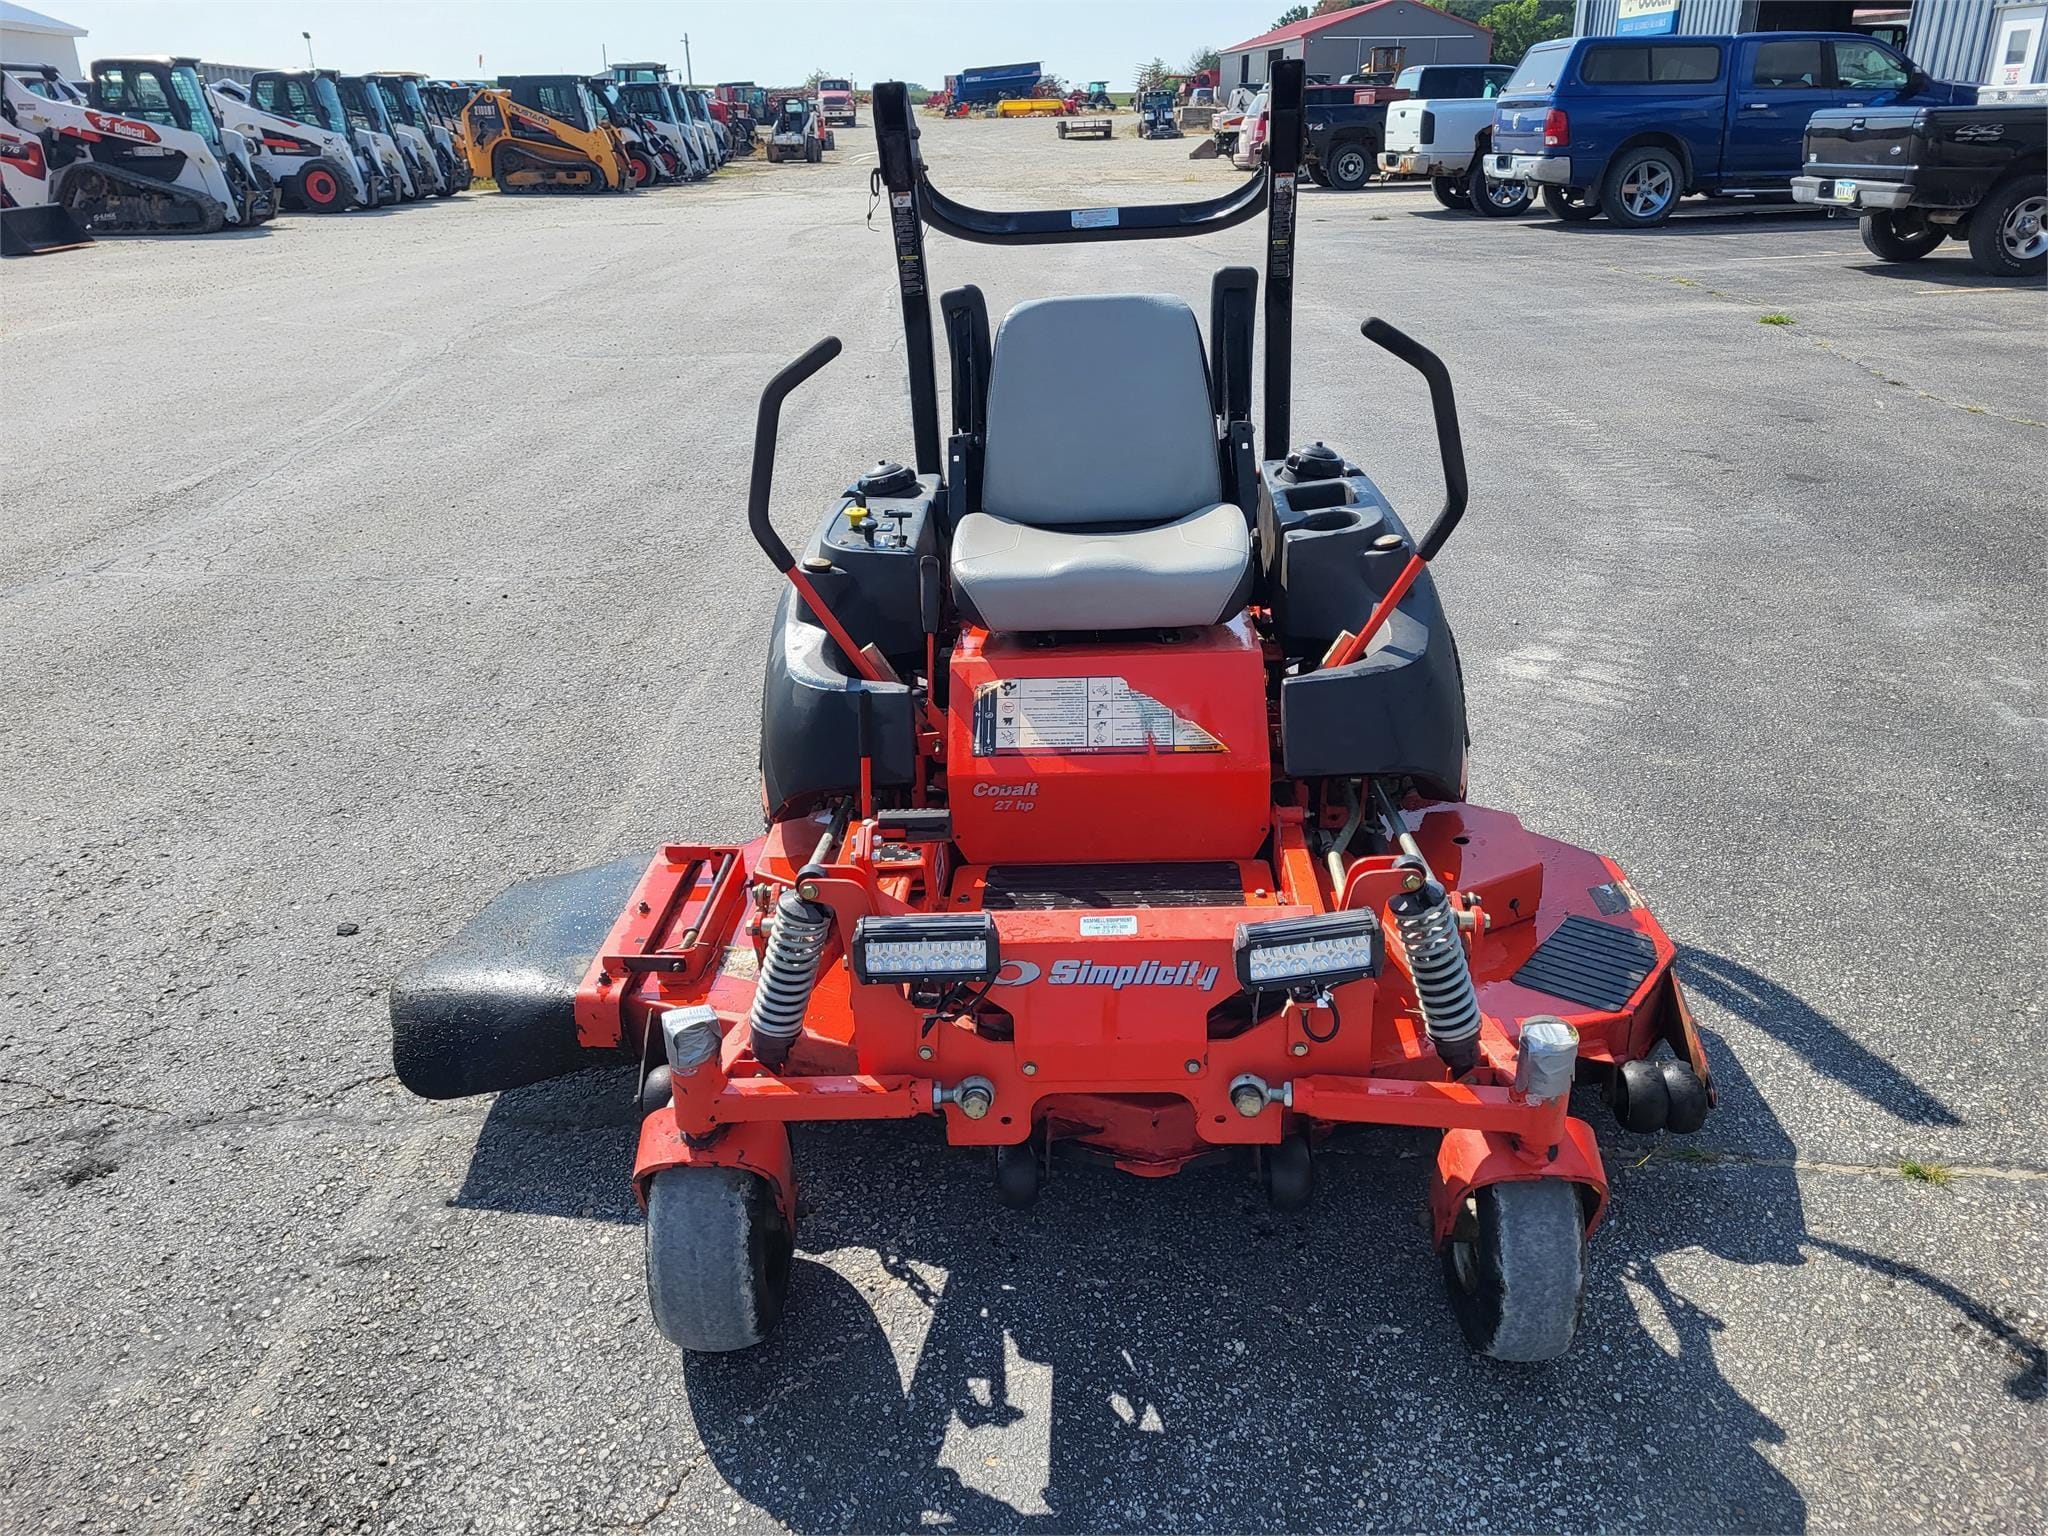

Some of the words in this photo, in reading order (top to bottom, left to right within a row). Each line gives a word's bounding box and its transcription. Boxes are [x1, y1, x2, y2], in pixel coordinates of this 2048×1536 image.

[114, 122, 146, 138] Bobcat
[973, 782, 1039, 797] Cobalt
[993, 800, 1012, 811] 27
[1016, 800, 1034, 812] hp
[1048, 959, 1220, 992] Simplicity
